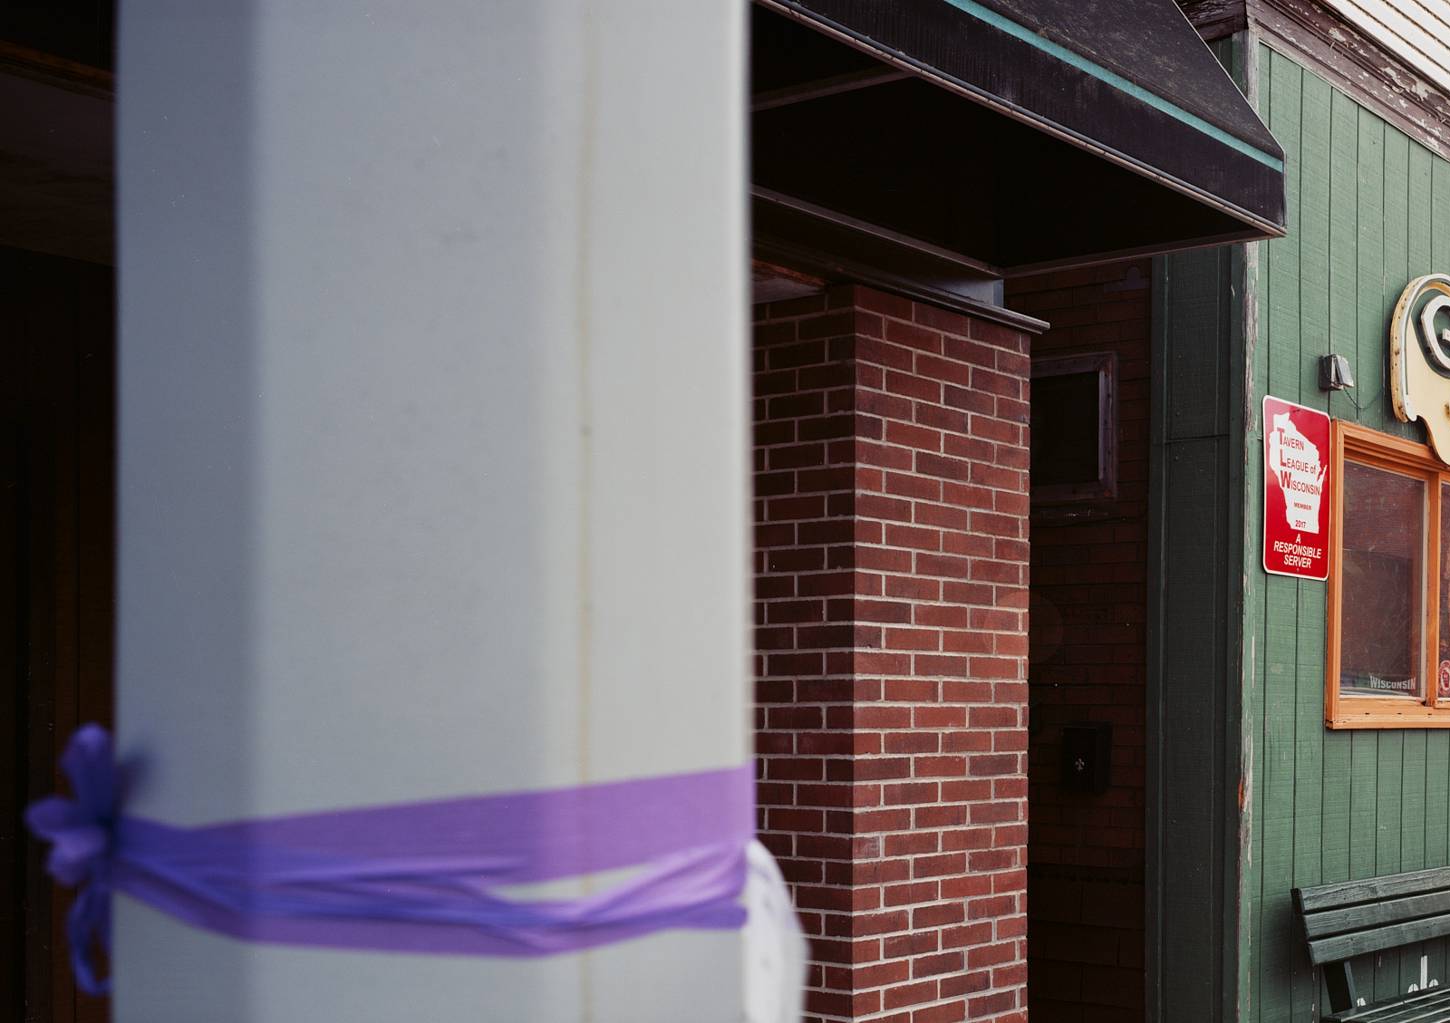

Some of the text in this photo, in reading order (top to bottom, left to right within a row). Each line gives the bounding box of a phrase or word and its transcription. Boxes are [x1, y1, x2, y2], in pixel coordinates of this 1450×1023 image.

[1310, 464, 1317, 475] of
[1294, 502, 1312, 511] MEMBER
[1295, 519, 1307, 528] 2017
[1295, 533, 1302, 545] A
[1273, 540, 1322, 559] RESPONSIBLE
[1283, 554, 1312, 569] SERVER
[1369, 675, 1417, 691] WISCONSIN
